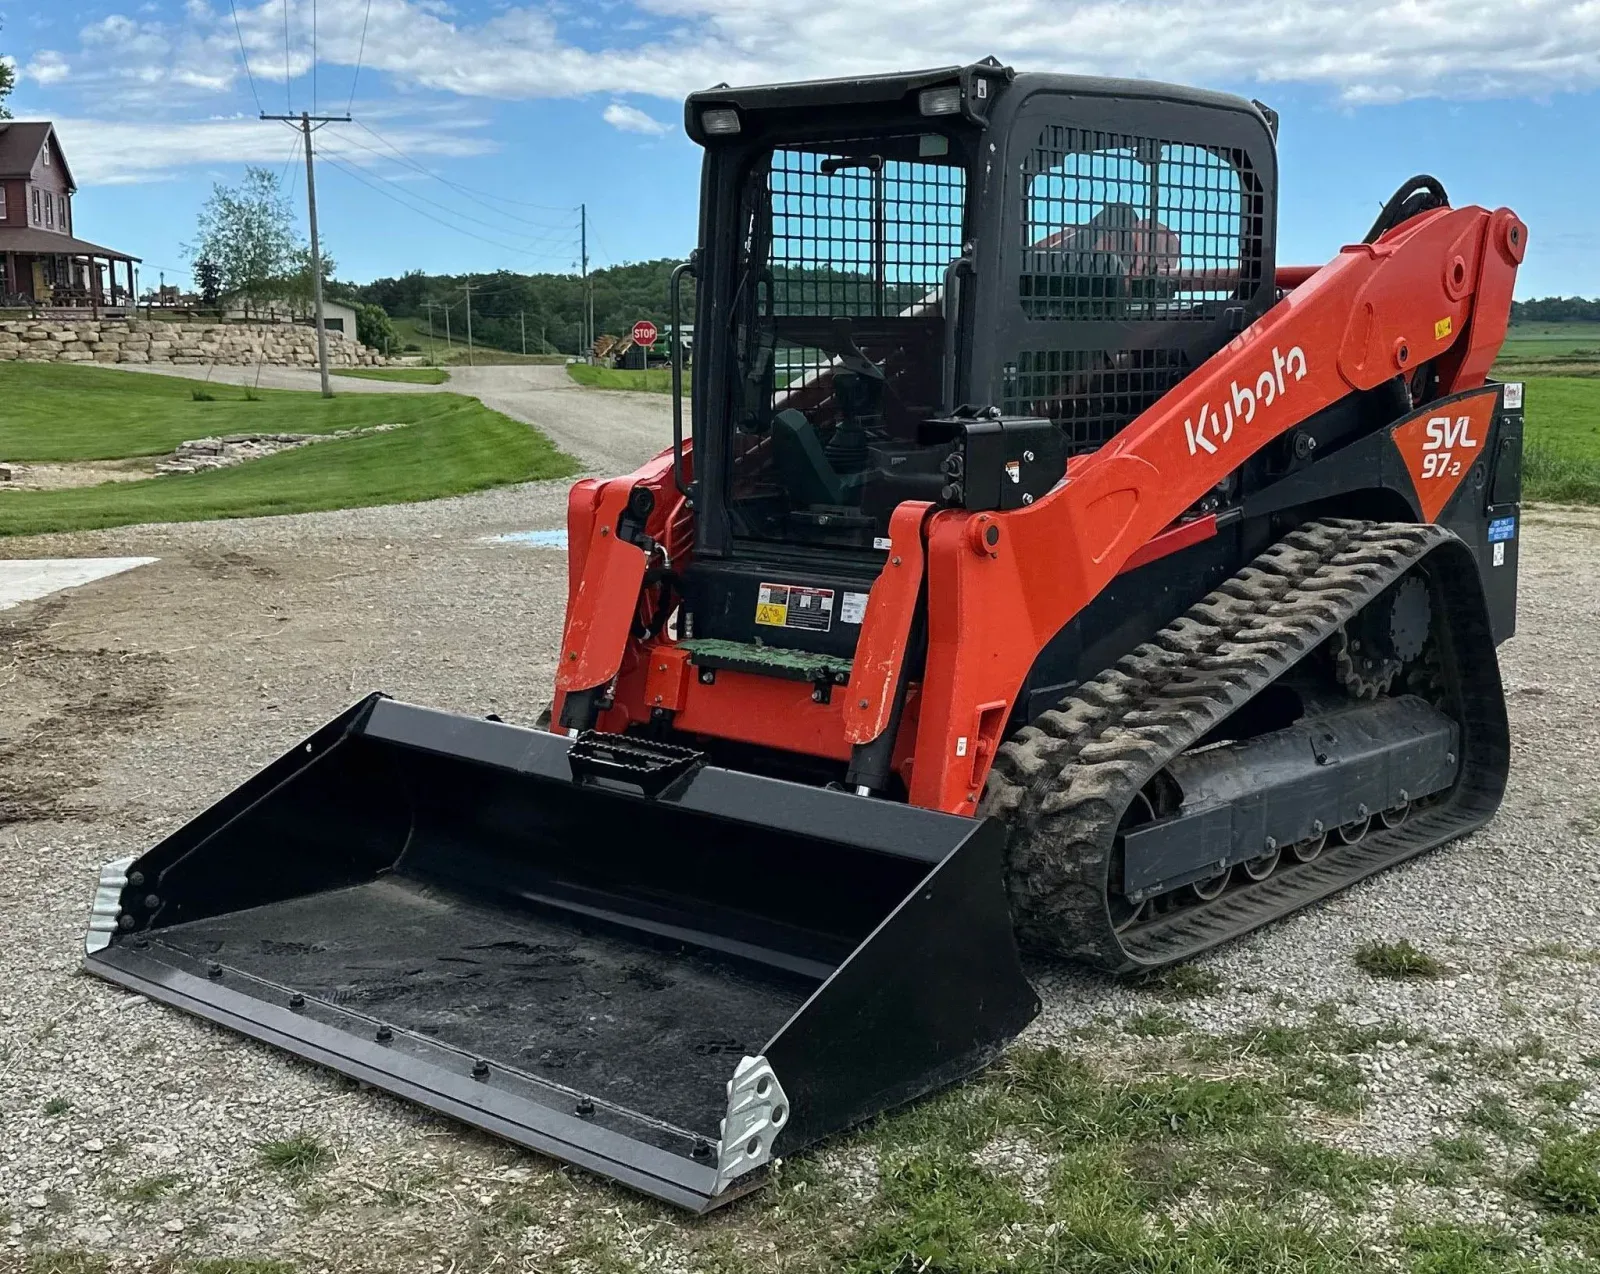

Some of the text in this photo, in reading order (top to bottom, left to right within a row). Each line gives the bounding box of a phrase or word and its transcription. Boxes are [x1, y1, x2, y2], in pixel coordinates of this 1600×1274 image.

[634, 328, 655, 339] STOP
[1184, 346, 1307, 456] Kubota
[1422, 416, 1477, 450] SVL
